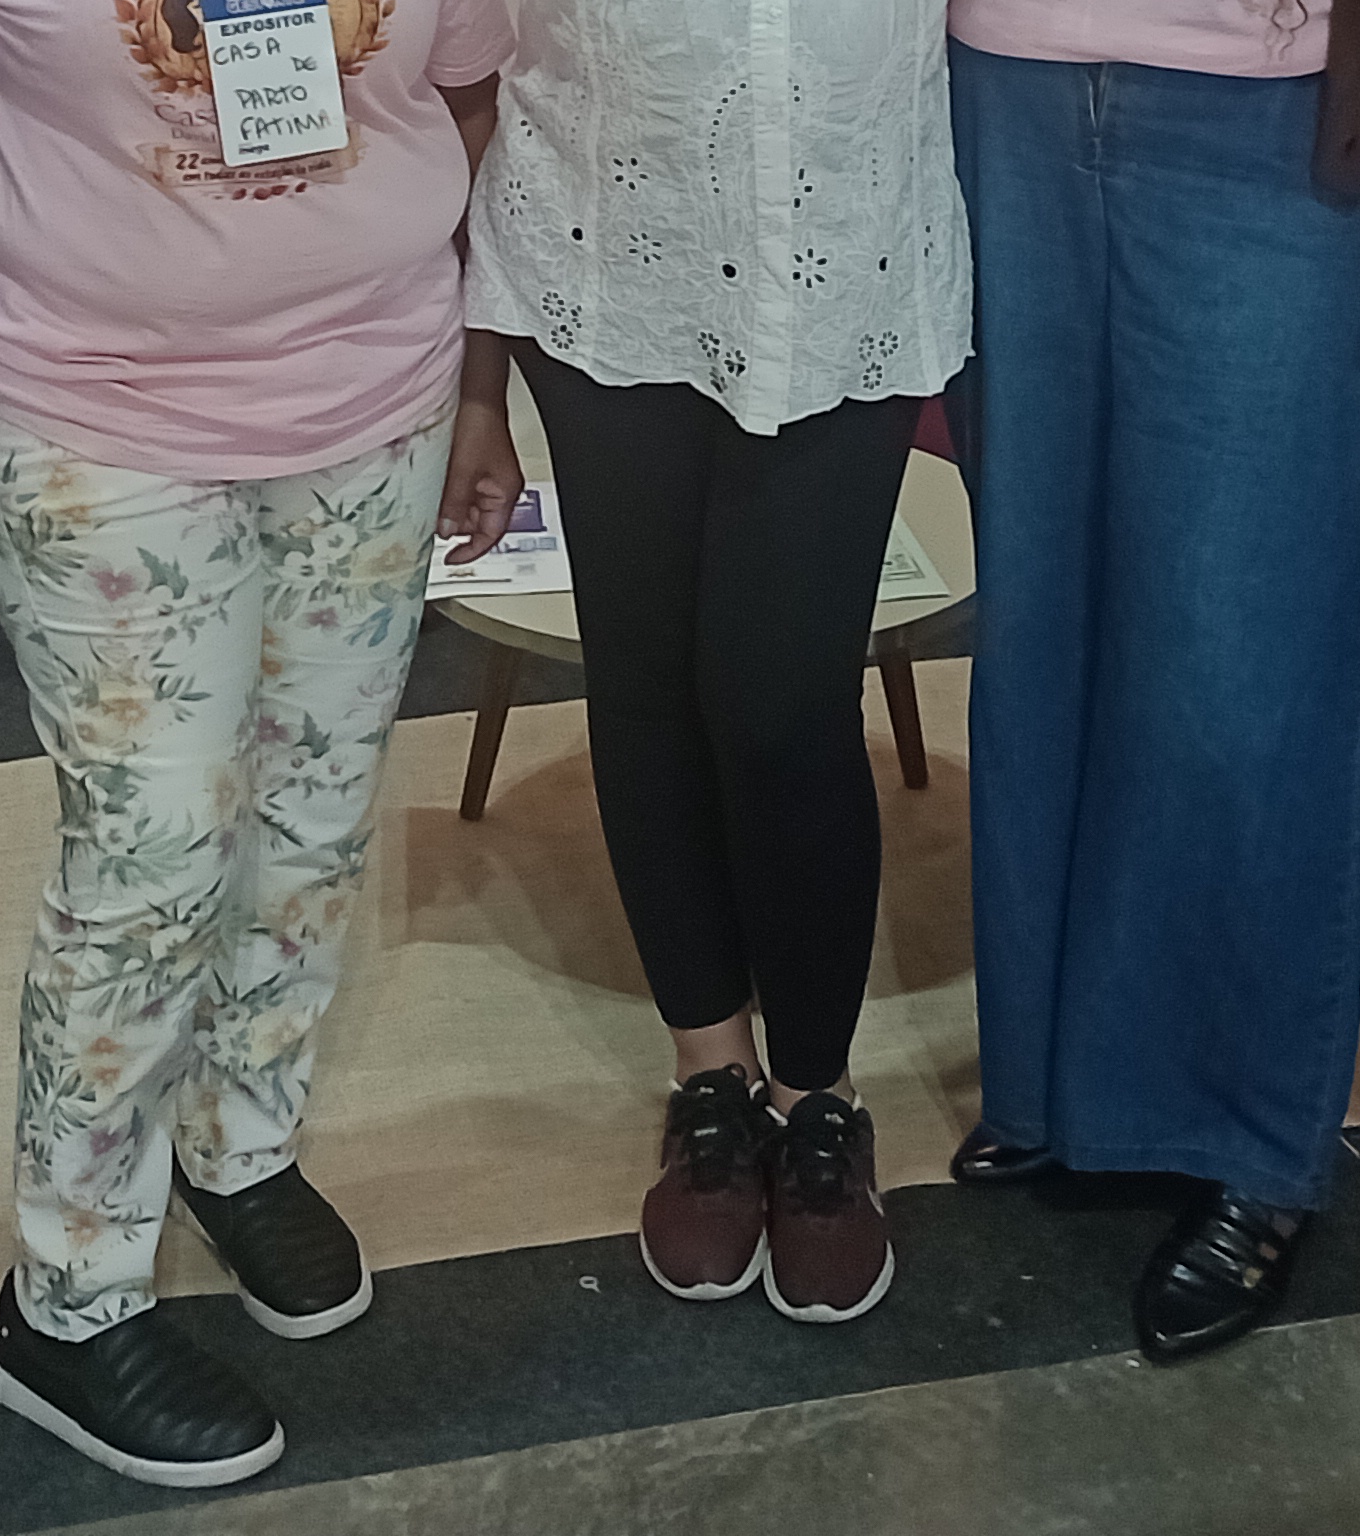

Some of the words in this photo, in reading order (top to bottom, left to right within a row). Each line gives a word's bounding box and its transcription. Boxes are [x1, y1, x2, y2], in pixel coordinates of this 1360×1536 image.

[220, 12, 315, 37] EXPOSITOR
[213, 37, 281, 65] CASA
[290, 56, 318, 72] DE
[234, 84, 308, 109] PARTO
[240, 109, 331, 140] FATIMA
[176, 153, 200, 170] 22
